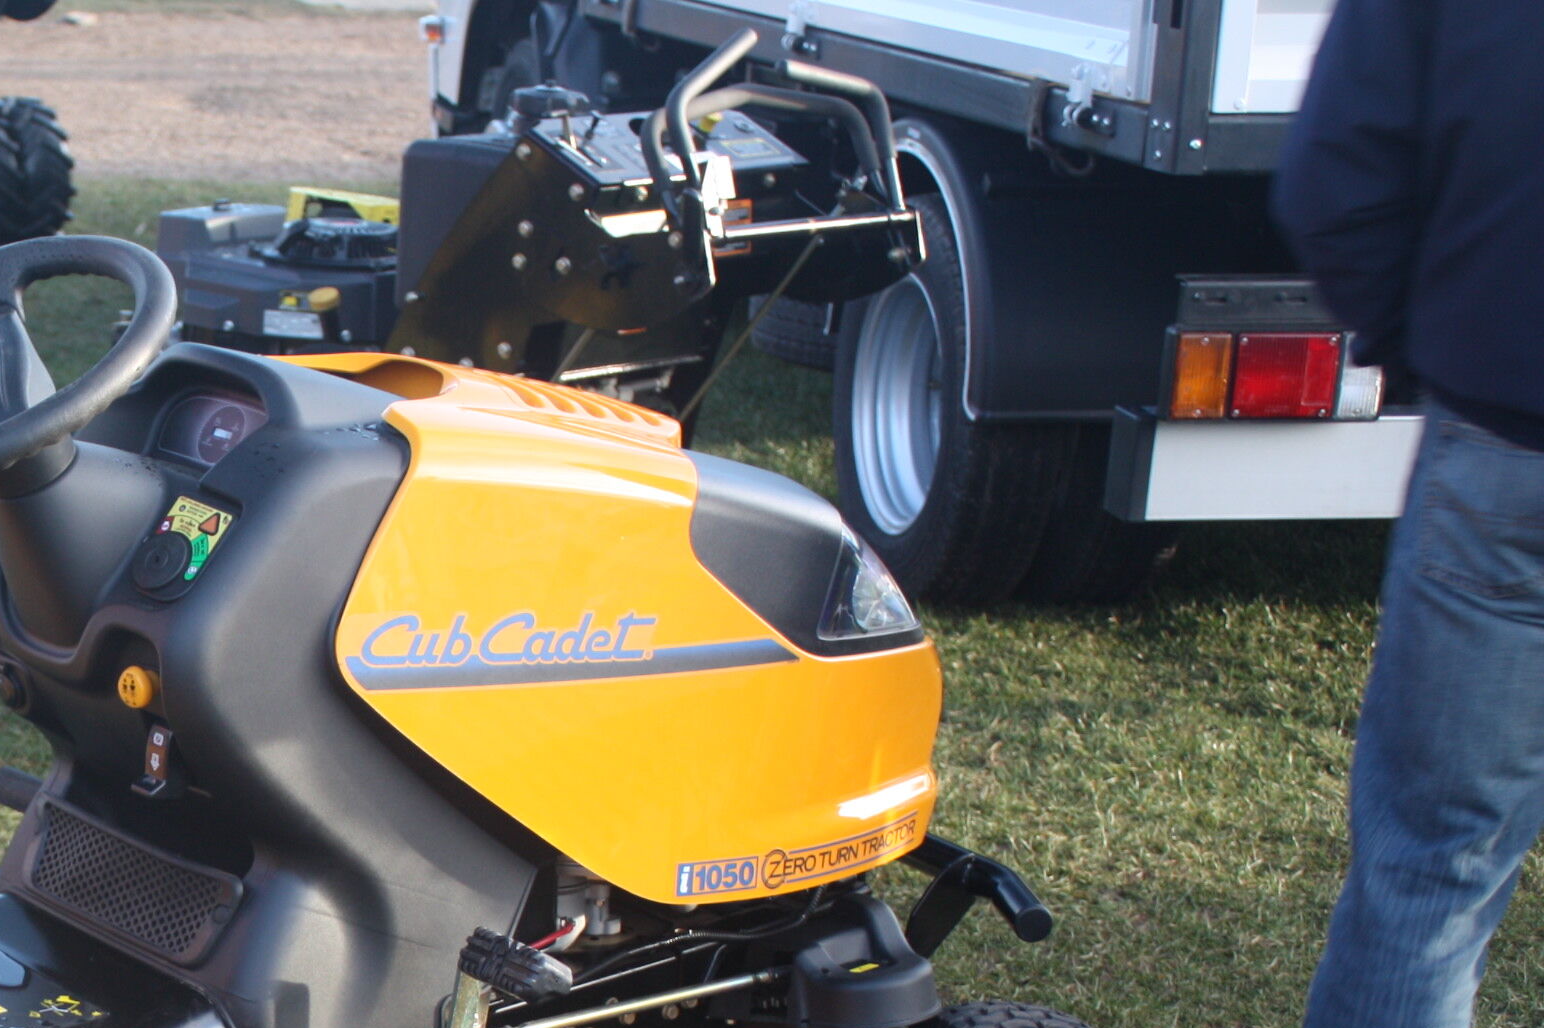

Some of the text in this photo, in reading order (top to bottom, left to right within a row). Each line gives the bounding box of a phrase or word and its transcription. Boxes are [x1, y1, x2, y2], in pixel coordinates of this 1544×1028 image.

[361, 612, 656, 666] Cub Cadet
[768, 851, 817, 884] ZERO
[819, 842, 860, 869] TURN
[861, 819, 917, 857] TRACTOR
